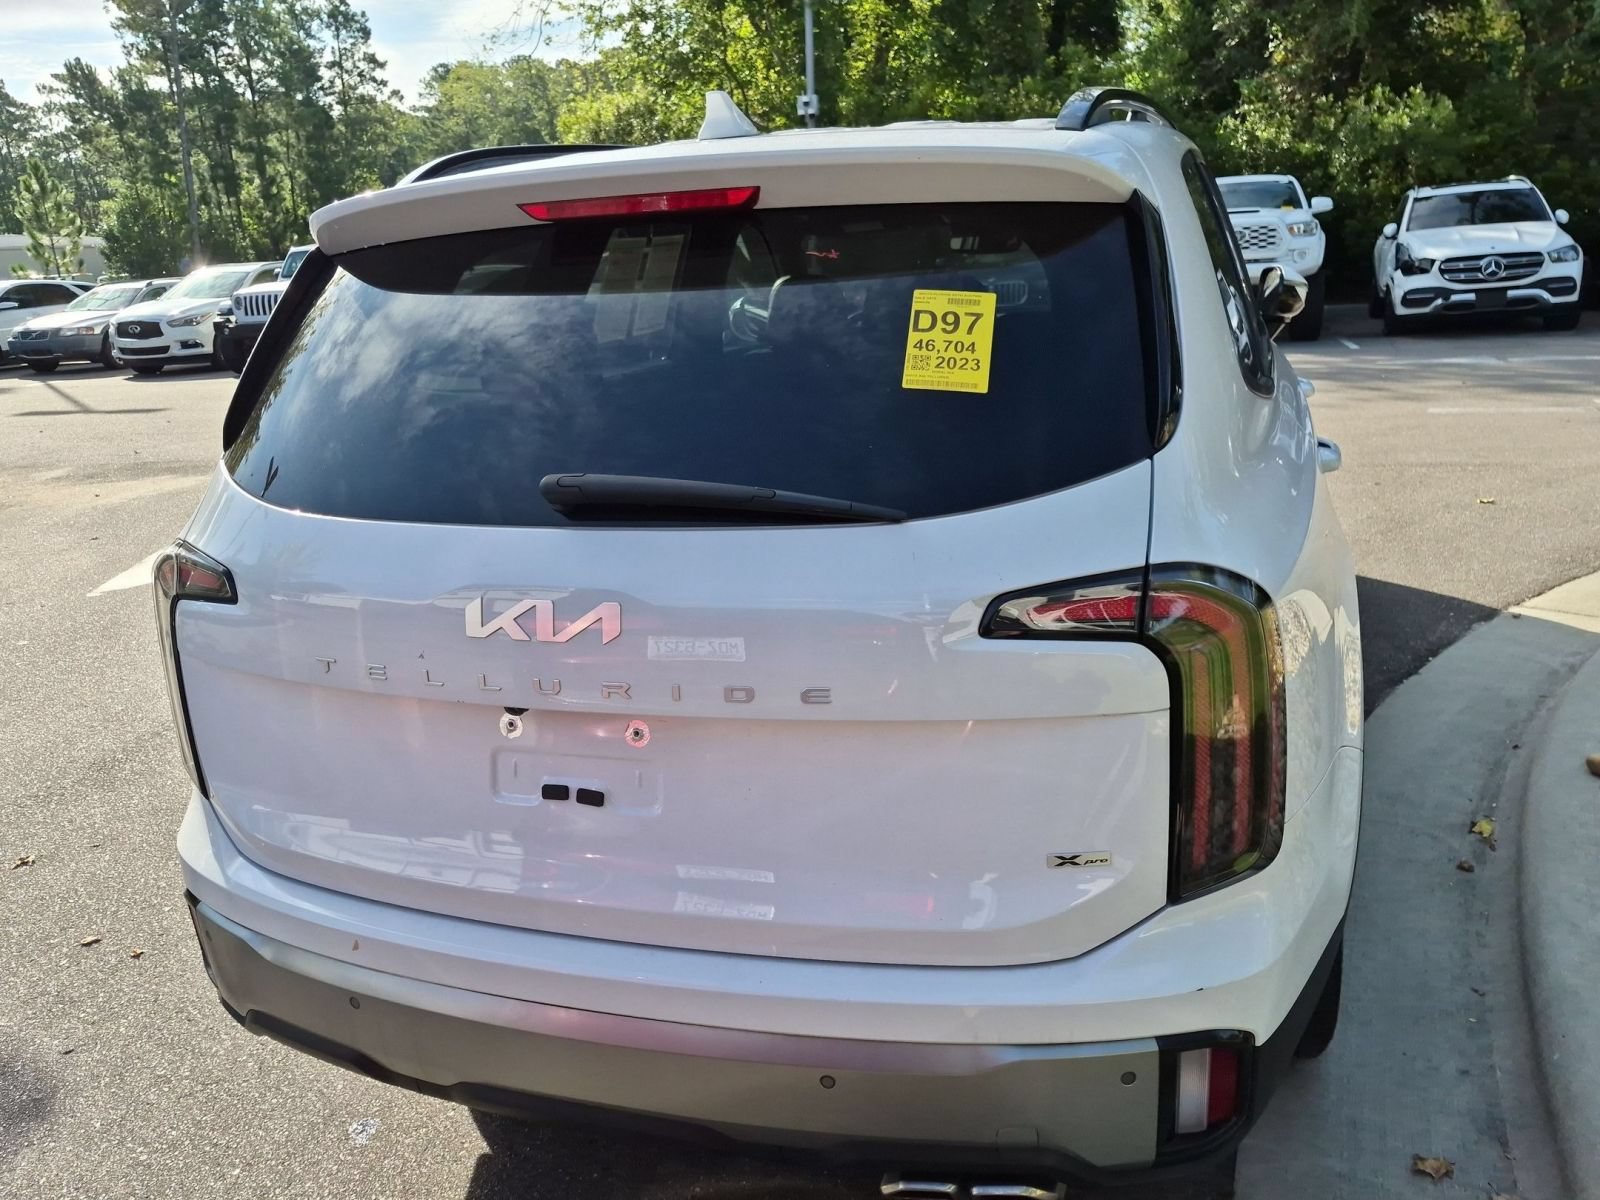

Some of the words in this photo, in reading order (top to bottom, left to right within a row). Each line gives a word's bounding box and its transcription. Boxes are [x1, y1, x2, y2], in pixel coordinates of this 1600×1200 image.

[912, 309, 984, 335] D97
[913, 339, 976, 354] 46,704
[934, 356, 981, 371] 2023
[465, 596, 621, 645] KIA
[315, 656, 832, 705] TELLURIDE
[1083, 858, 1109, 866] pro
